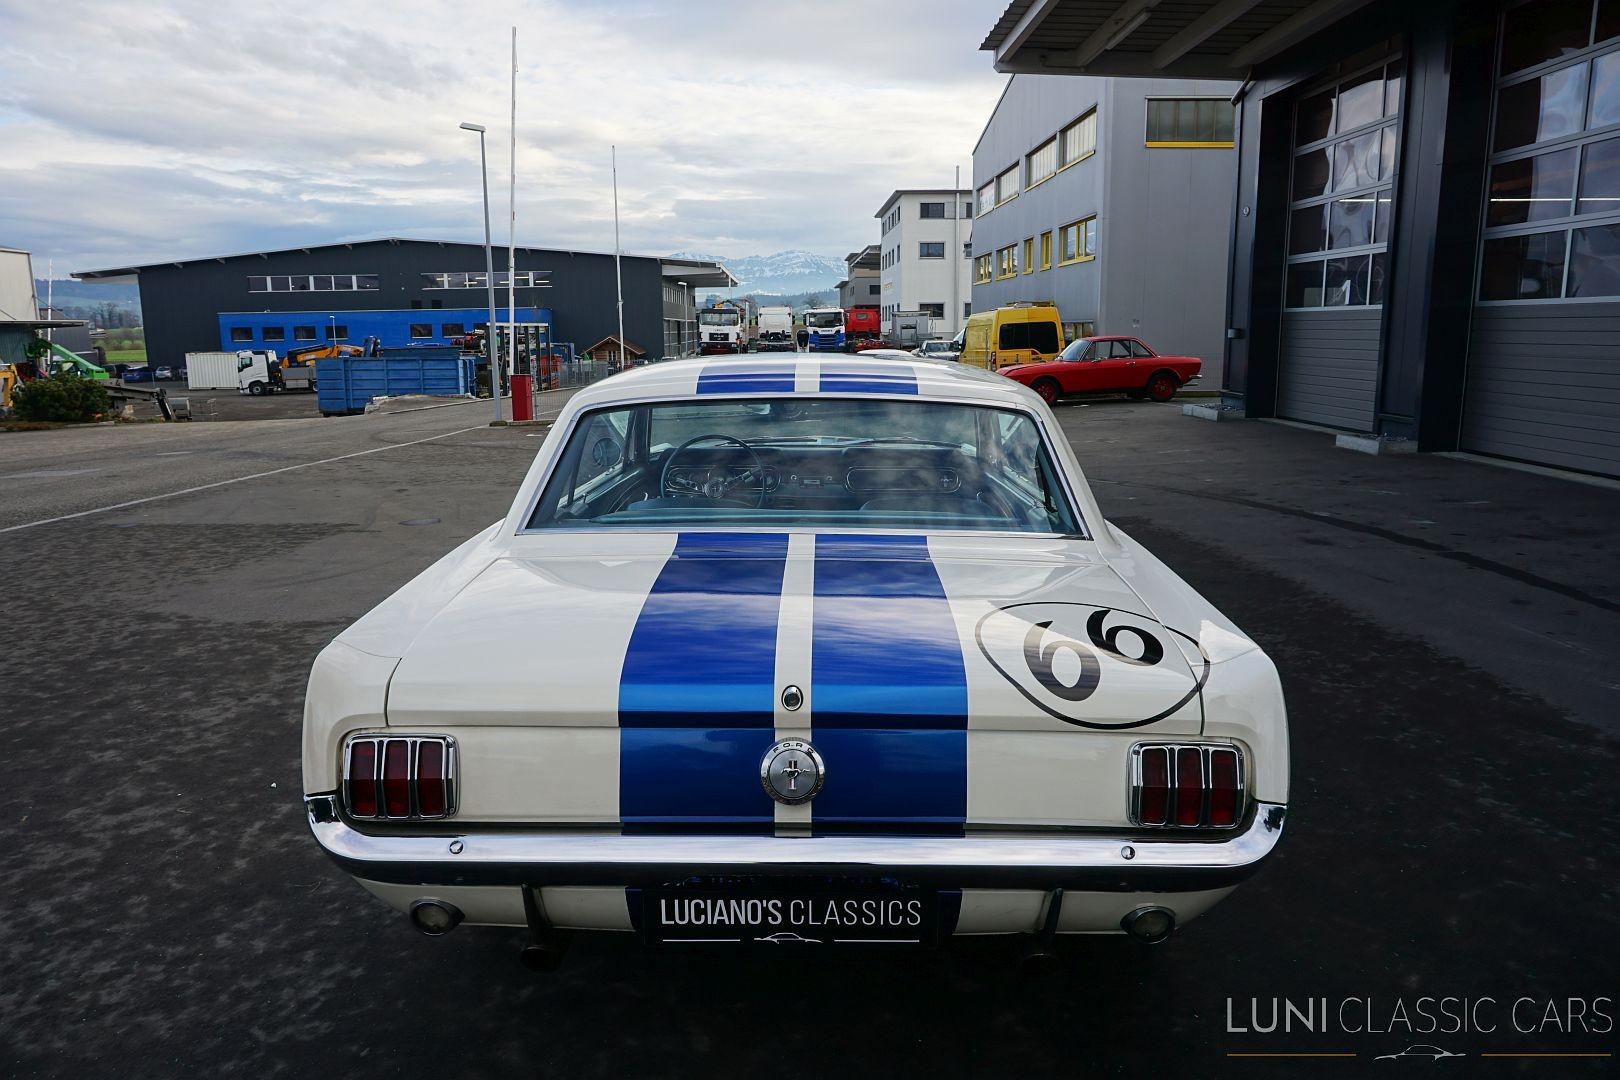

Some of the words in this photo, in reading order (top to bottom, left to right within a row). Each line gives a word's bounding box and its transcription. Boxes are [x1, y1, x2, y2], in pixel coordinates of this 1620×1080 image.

[1341, 279, 1352, 305] 1
[1023, 609, 1164, 701] 66
[772, 742, 815, 754] FORD
[660, 898, 783, 925] LUCIANO'S
[790, 899, 921, 926] CLASSICS
